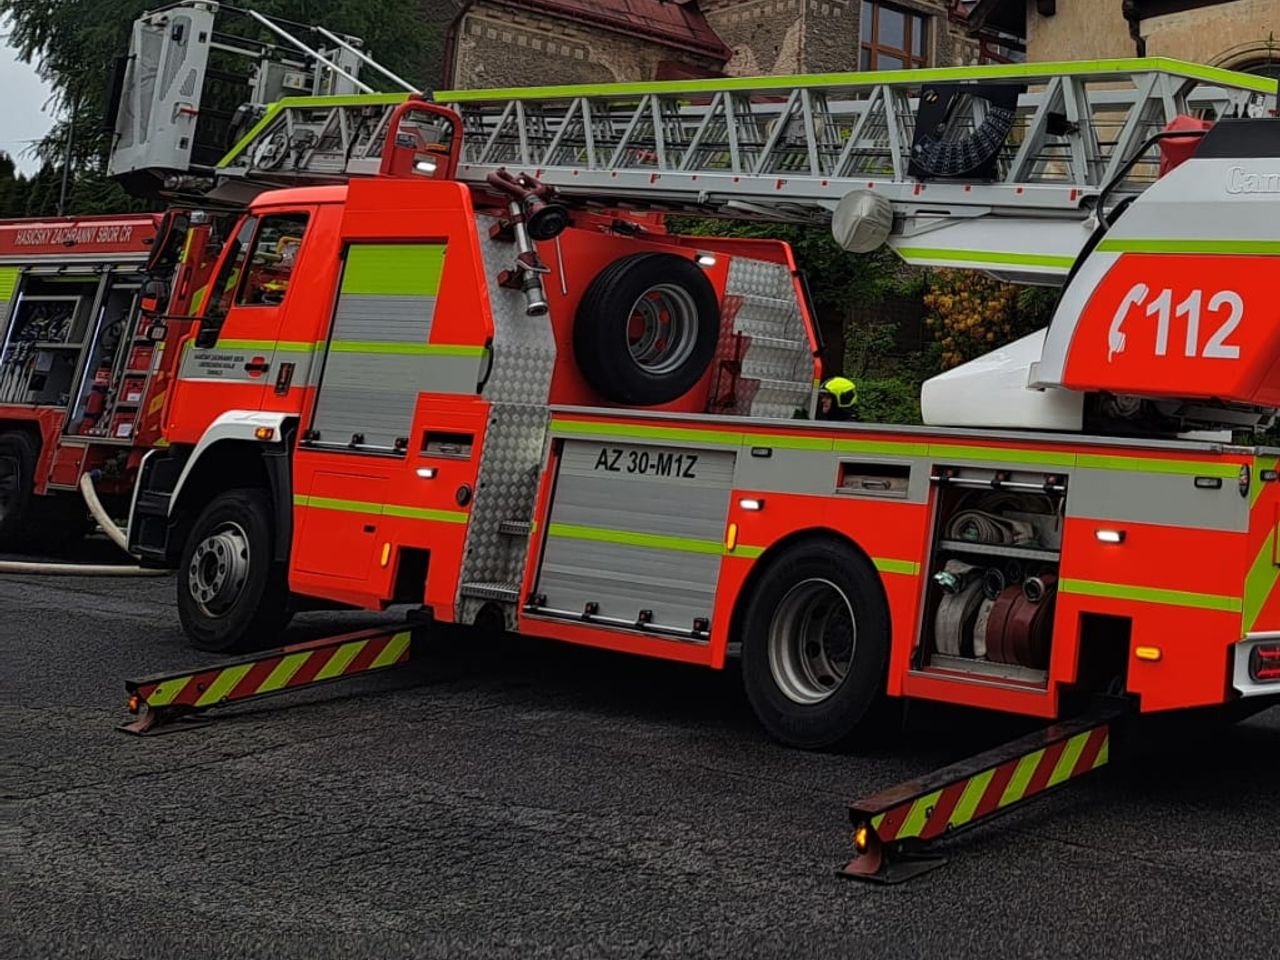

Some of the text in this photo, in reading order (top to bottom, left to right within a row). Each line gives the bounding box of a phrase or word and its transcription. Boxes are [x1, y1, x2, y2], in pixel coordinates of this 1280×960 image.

[1146, 289, 1244, 359] 112
[594, 447, 699, 478] AZ 30-M1Z
